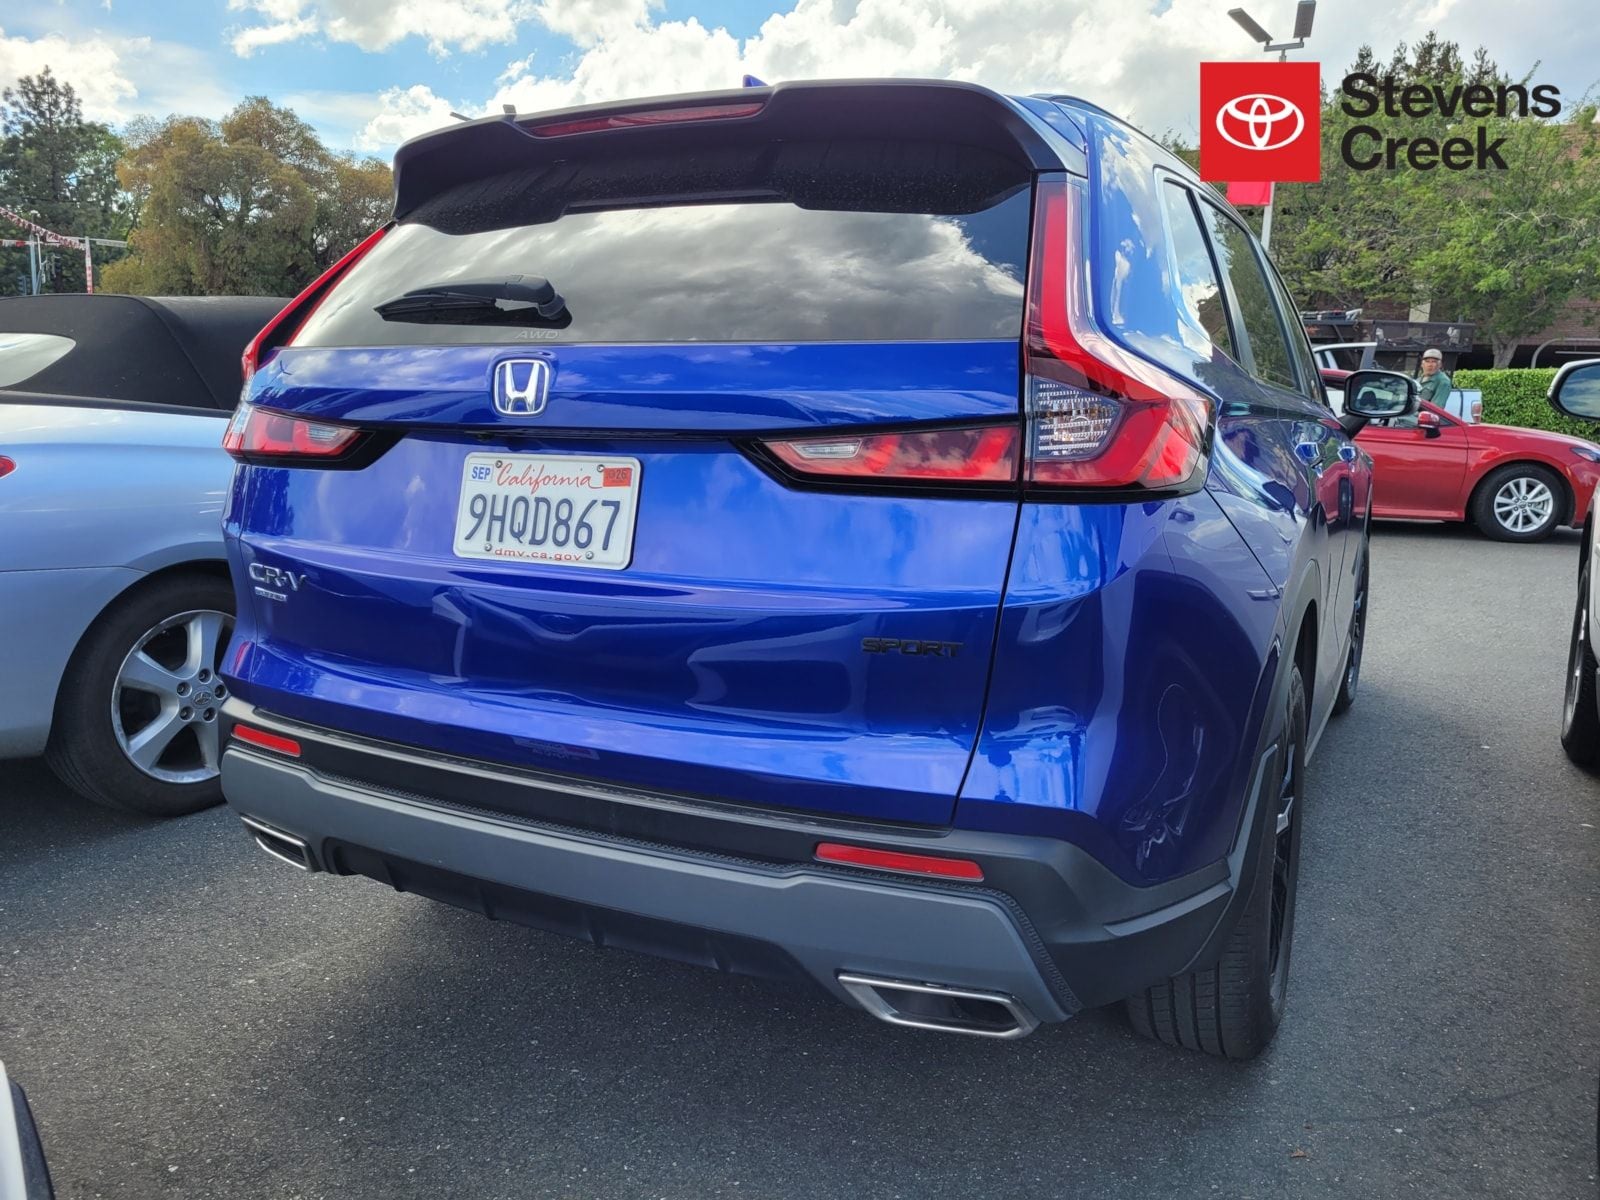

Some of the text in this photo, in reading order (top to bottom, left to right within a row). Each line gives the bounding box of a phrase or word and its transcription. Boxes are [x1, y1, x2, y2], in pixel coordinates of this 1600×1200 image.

[515, 330, 559, 339] AWD
[471, 466, 491, 480] SEP
[497, 463, 602, 494] California
[465, 493, 620, 550] 9HQD867
[495, 548, 582, 561] dmv.ca.gov
[862, 637, 964, 657] SPORT
